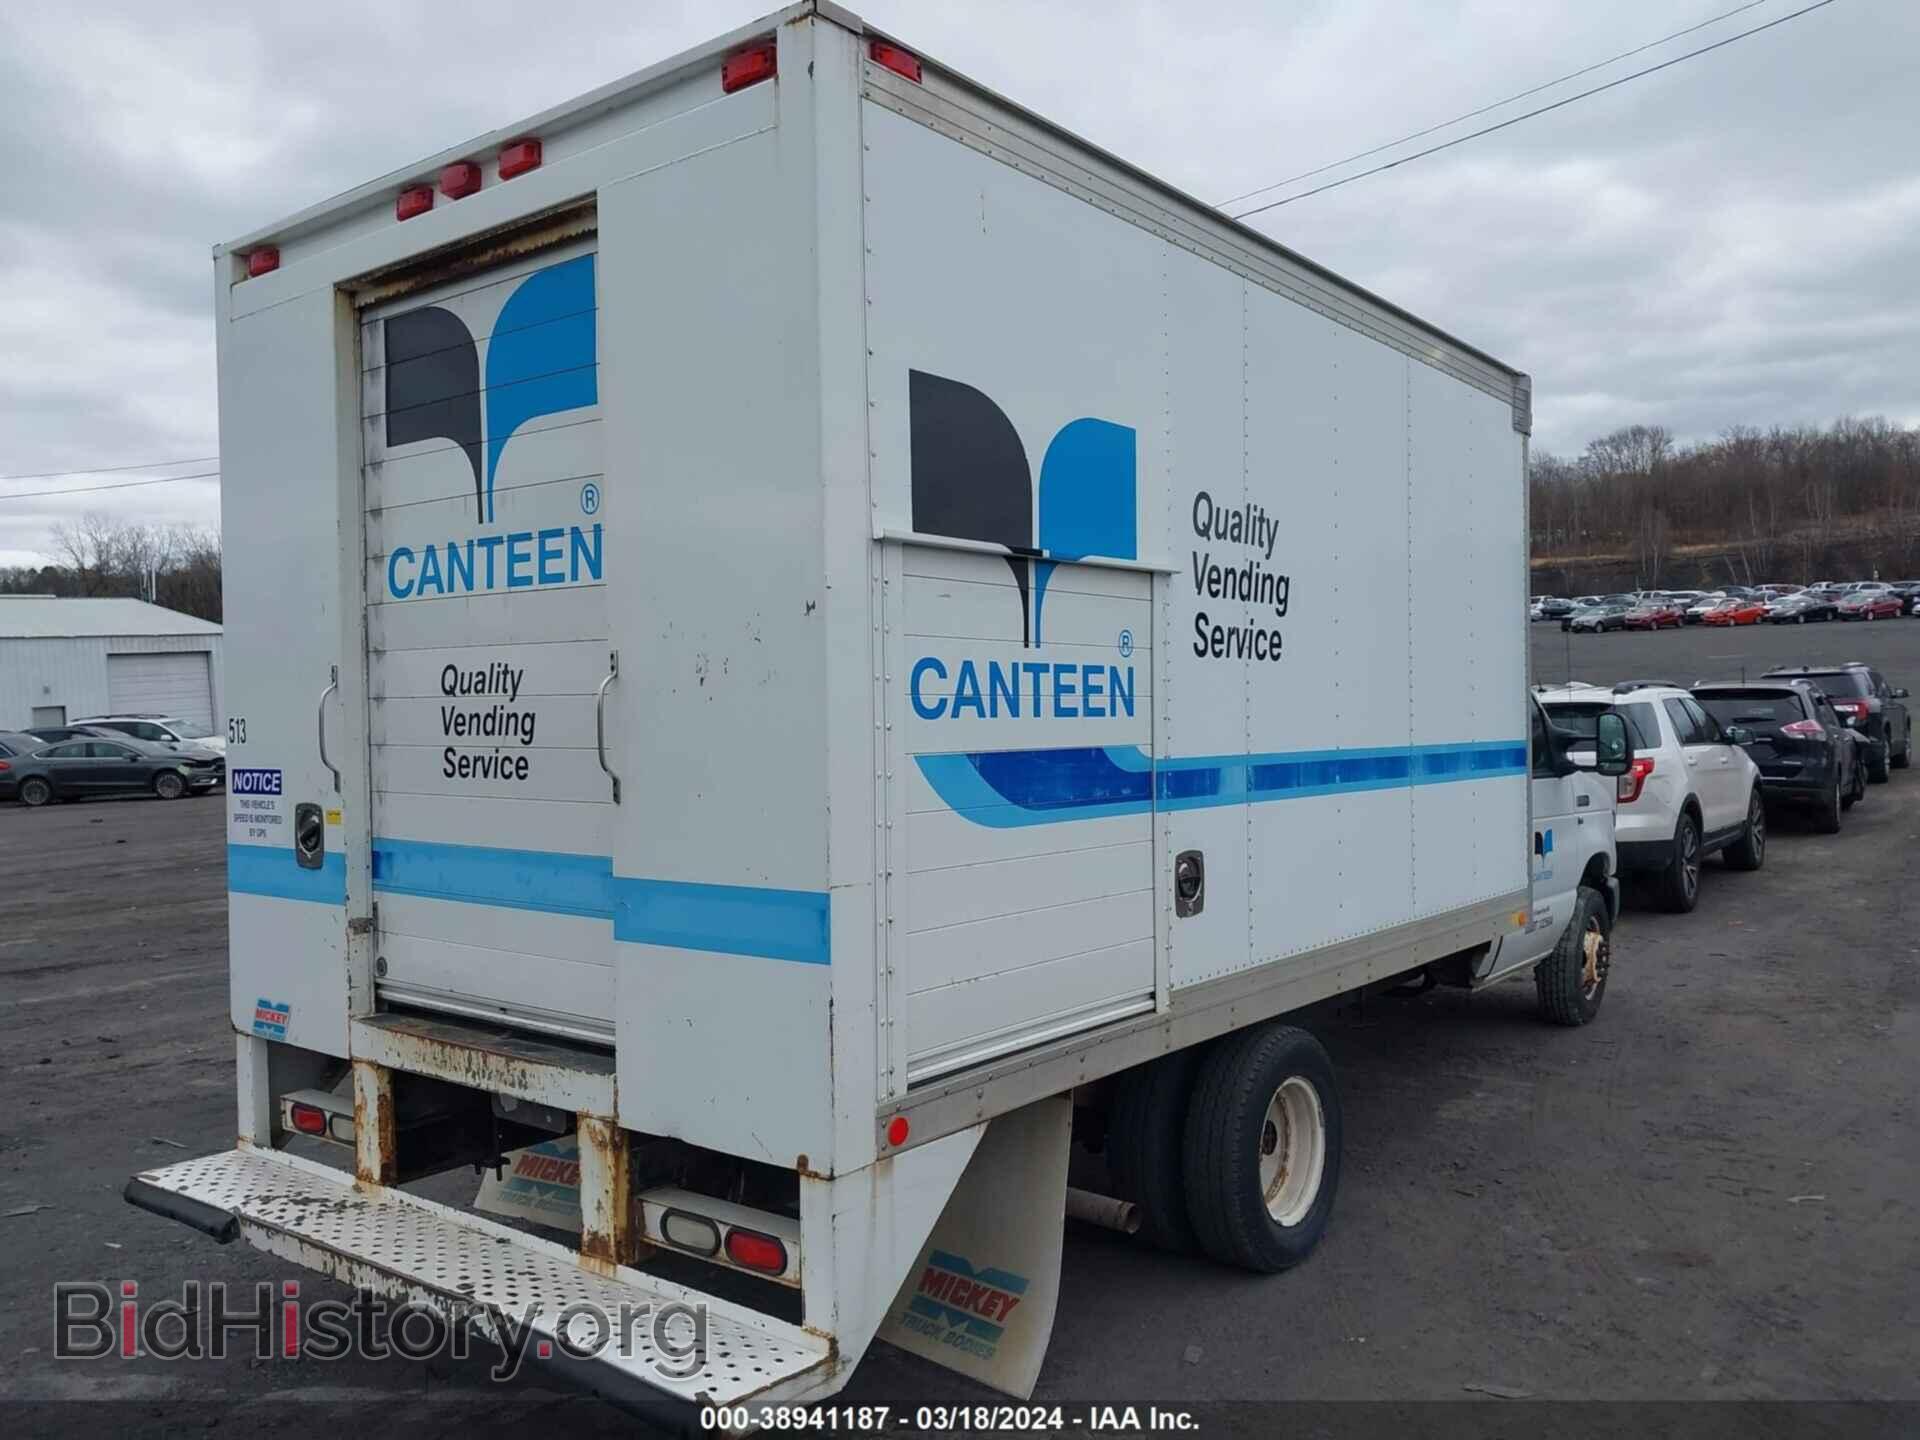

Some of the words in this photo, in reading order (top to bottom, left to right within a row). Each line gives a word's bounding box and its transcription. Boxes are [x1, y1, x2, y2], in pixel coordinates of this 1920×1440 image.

[1192, 491, 1279, 560] Quality
[388, 523, 603, 599] CANTEEN
[1192, 551, 1290, 617] Vending
[1193, 612, 1282, 662] Service
[441, 663, 524, 702] Quality
[910, 656, 1135, 720] CANTEEN
[228, 718, 247, 744] 513
[441, 705, 536, 746] Vending
[233, 772, 281, 792] NOTICE
[443, 747, 529, 780] Service
[256, 1008, 288, 1025] MICKEY
[513, 1155, 581, 1185] MICKE
[917, 1267, 1021, 1323] MICKEY
